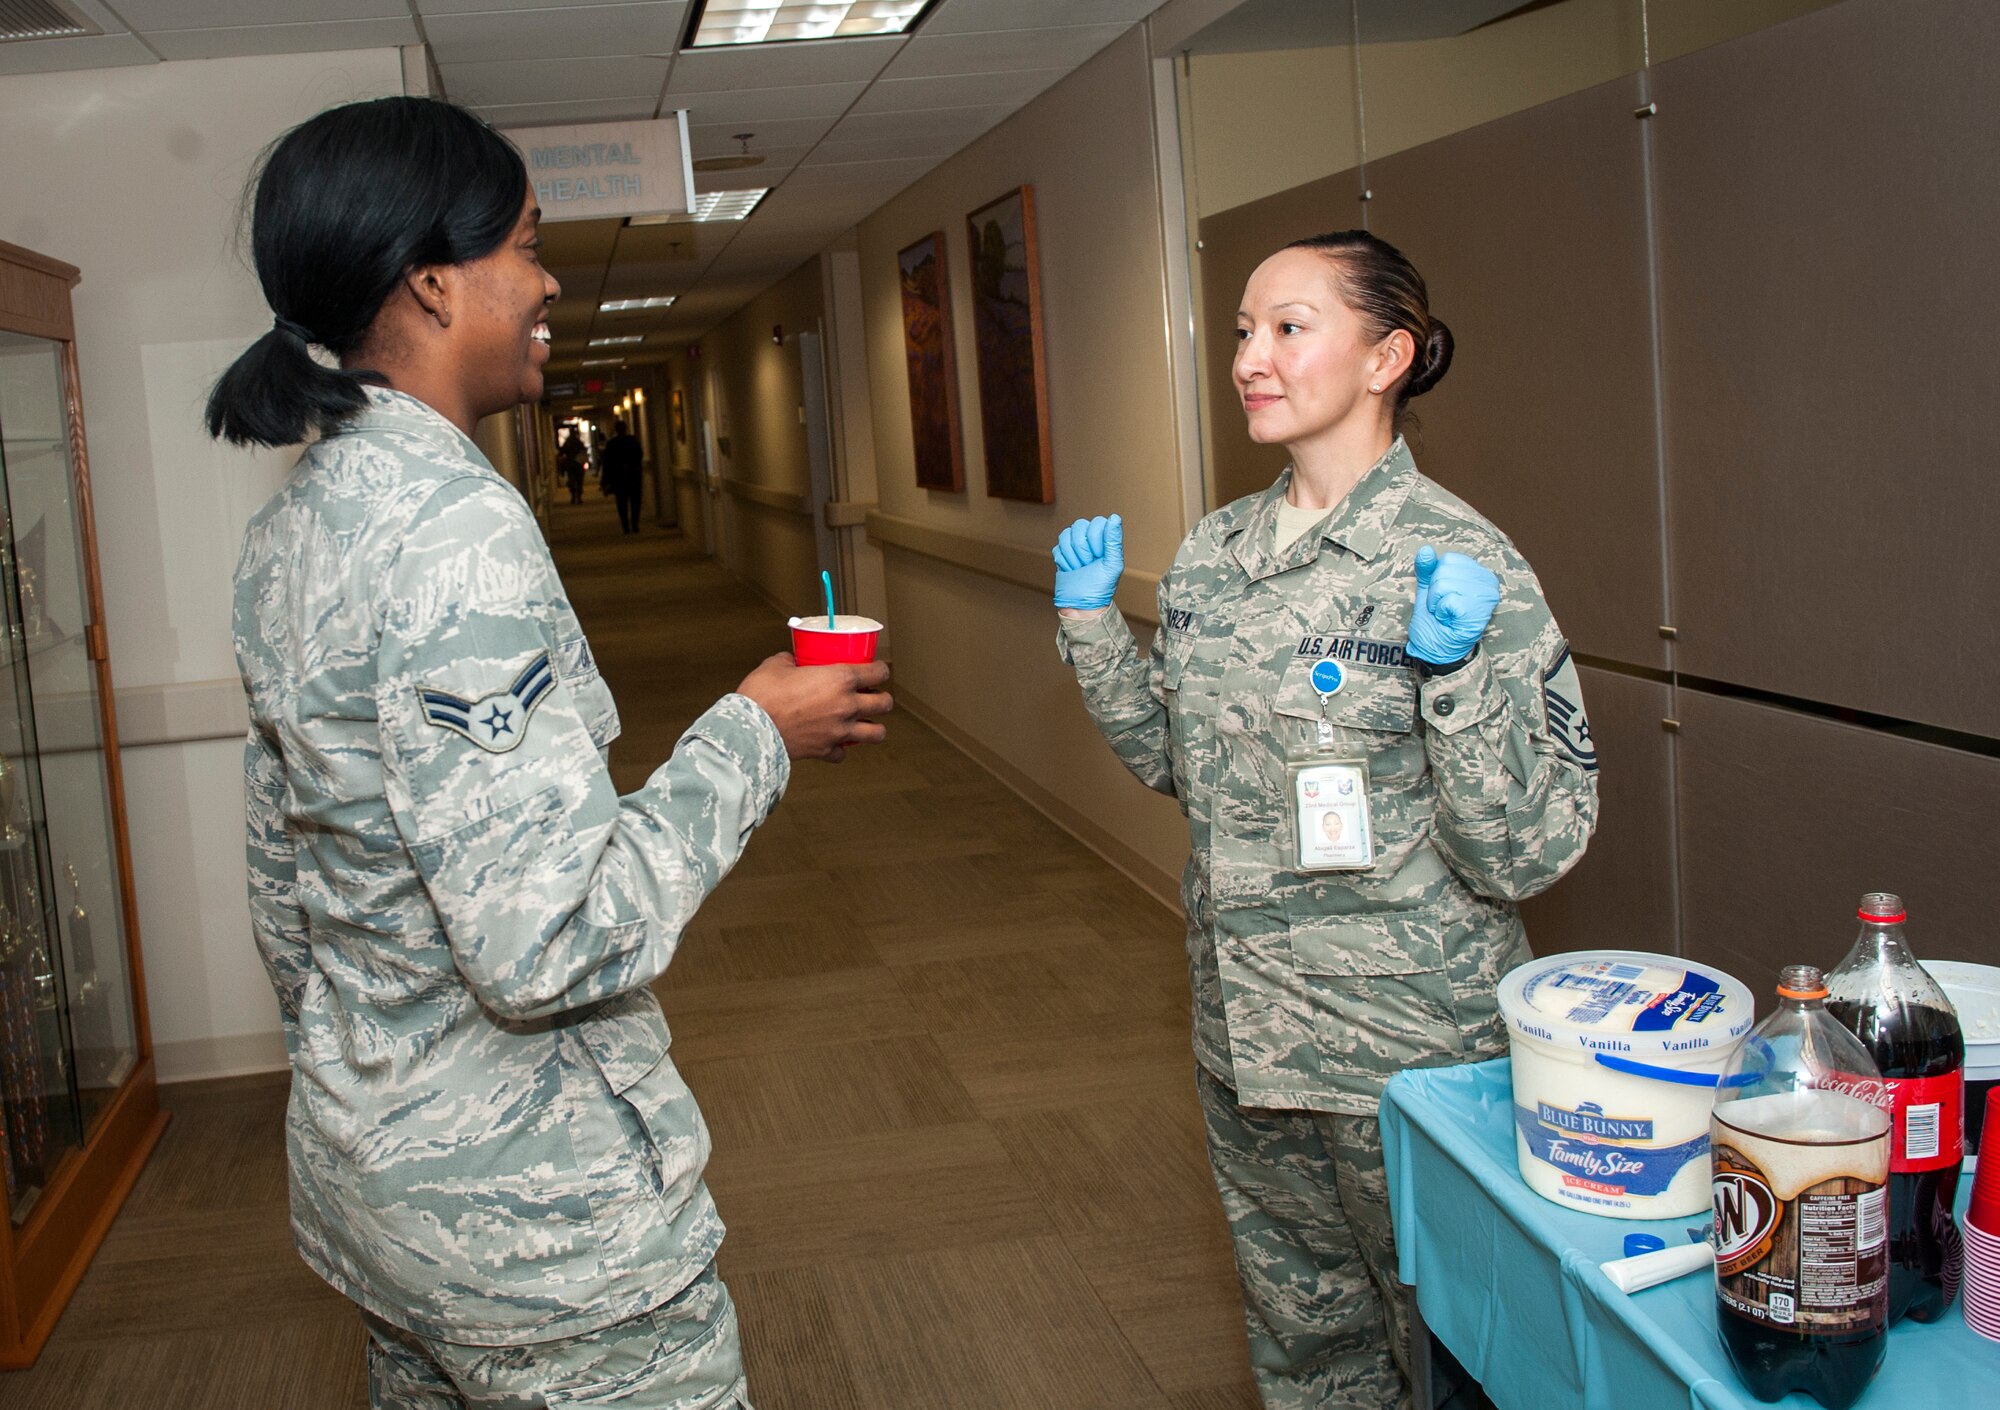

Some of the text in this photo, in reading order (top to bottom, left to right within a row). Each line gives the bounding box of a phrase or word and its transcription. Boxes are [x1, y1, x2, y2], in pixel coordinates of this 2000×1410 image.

[531, 143, 641, 169] MENTAL
[535, 175, 642, 201] HEALTH
[1298, 637, 1410, 667] U.S. AIR FORCE
[1517, 1019, 1552, 1040] Vanilla
[1579, 1036, 1631, 1051] Vanilla
[1662, 1038, 1709, 1051] Vanilla
[1543, 1105, 1645, 1137] BLUE BUNNY
[1547, 1139, 1644, 1175] Family Size
[1566, 1176, 1620, 1194] ICE CREAM
[1740, 1248, 1763, 1266] BEER
[1774, 1296, 1790, 1307] 170
